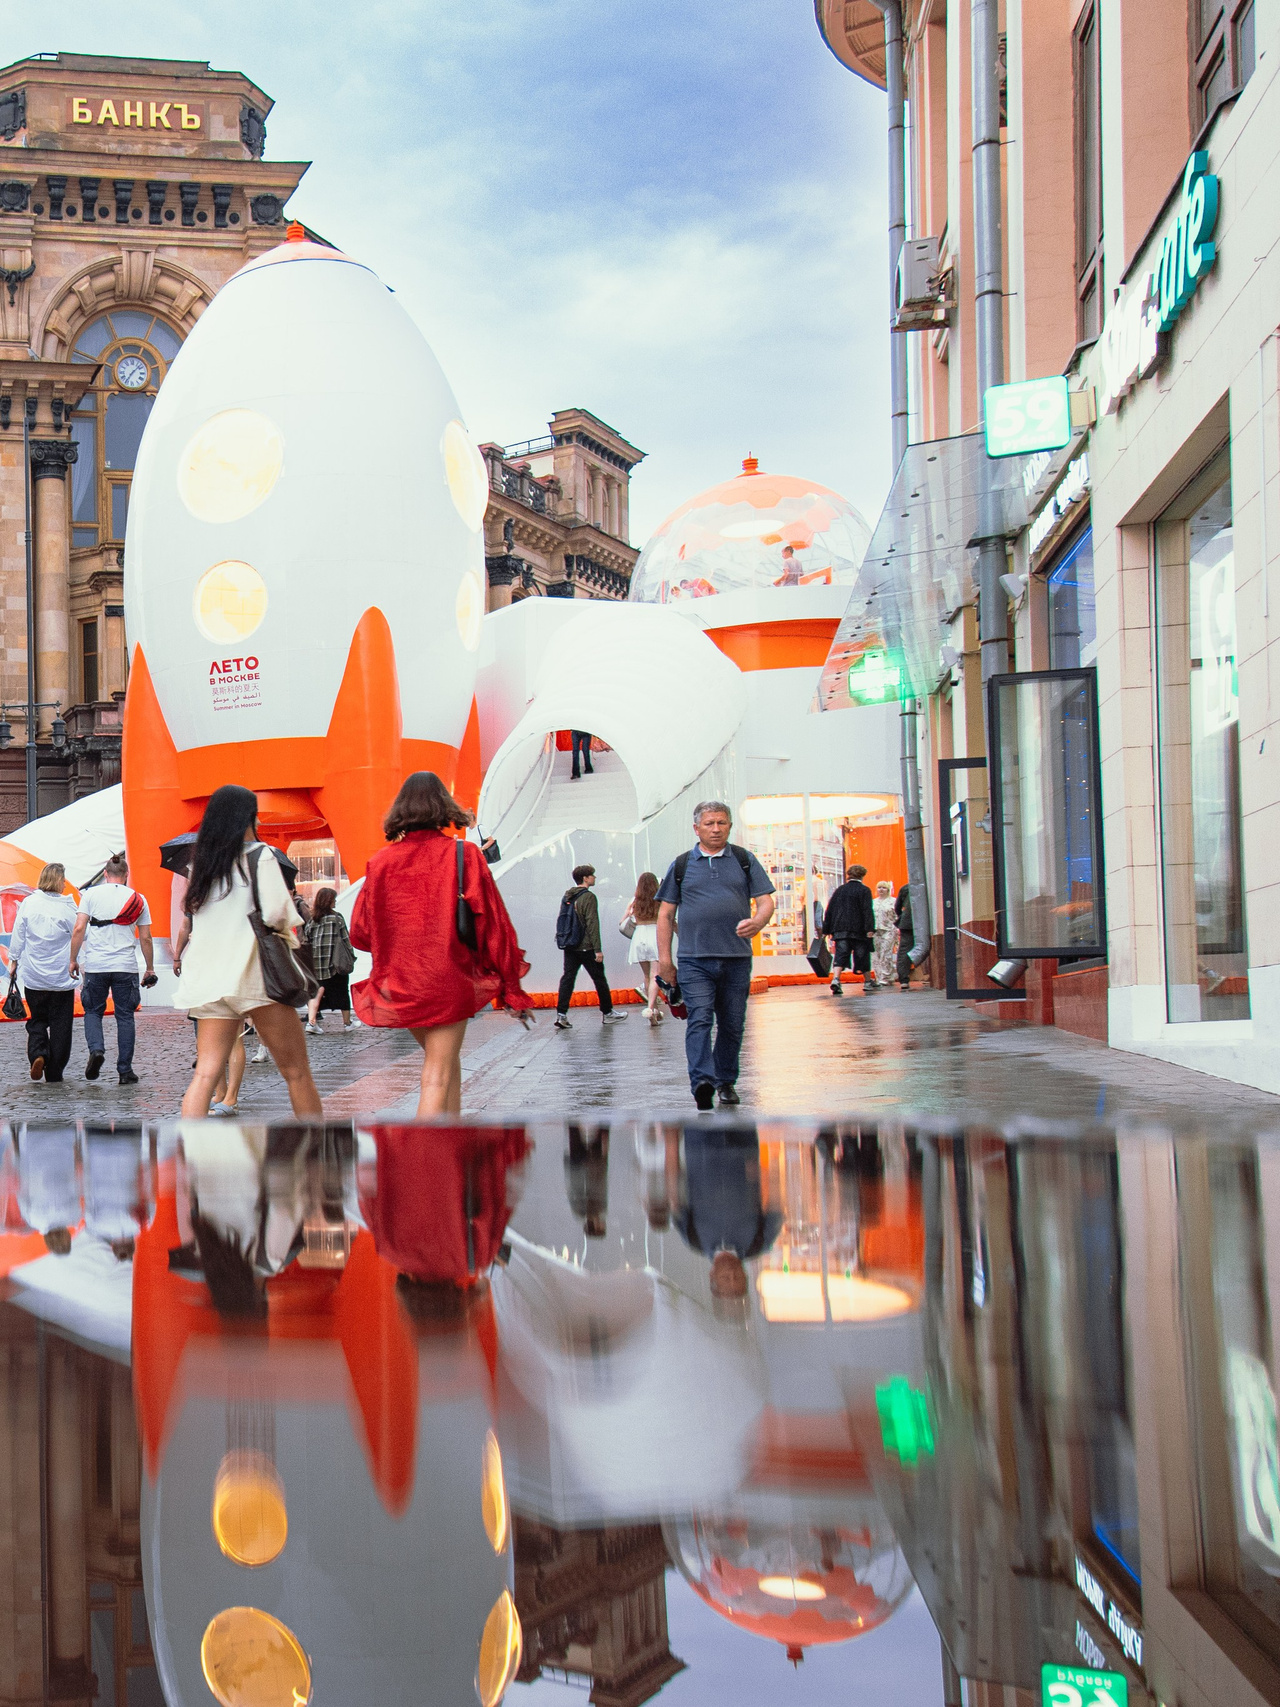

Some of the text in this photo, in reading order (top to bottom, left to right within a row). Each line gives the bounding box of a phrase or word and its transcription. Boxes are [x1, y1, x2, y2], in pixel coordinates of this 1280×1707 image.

[72, 97, 201, 130] БАНКЪ
[991, 390, 1065, 438] 59
[209, 656, 259, 675] ЛЕТО
[218, 673, 260, 684] МОСКВЕ
